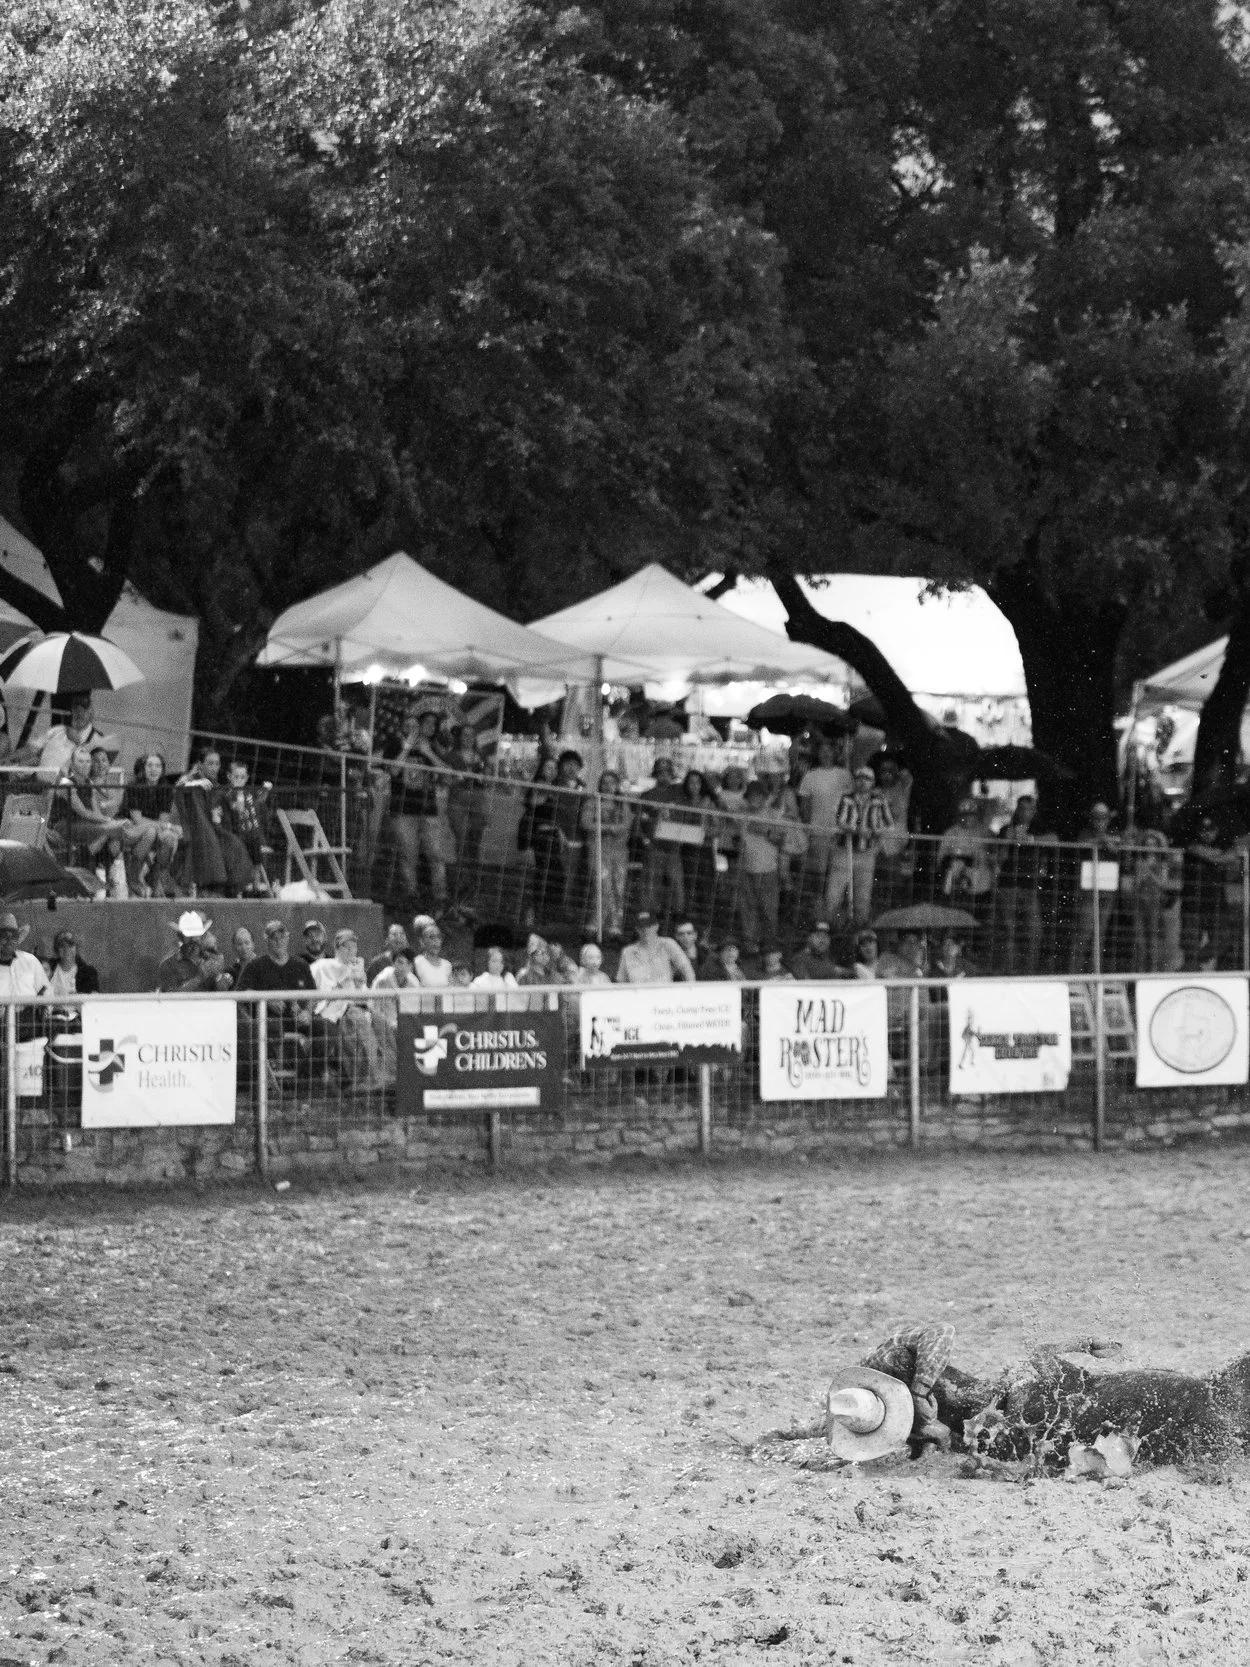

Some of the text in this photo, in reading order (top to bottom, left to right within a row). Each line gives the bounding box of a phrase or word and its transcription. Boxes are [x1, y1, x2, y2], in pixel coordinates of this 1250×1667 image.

[795, 998, 845, 1034] MAD
[138, 1043, 232, 1064] CHRISTUS
[455, 1051, 547, 1072] CHILDREN'S
